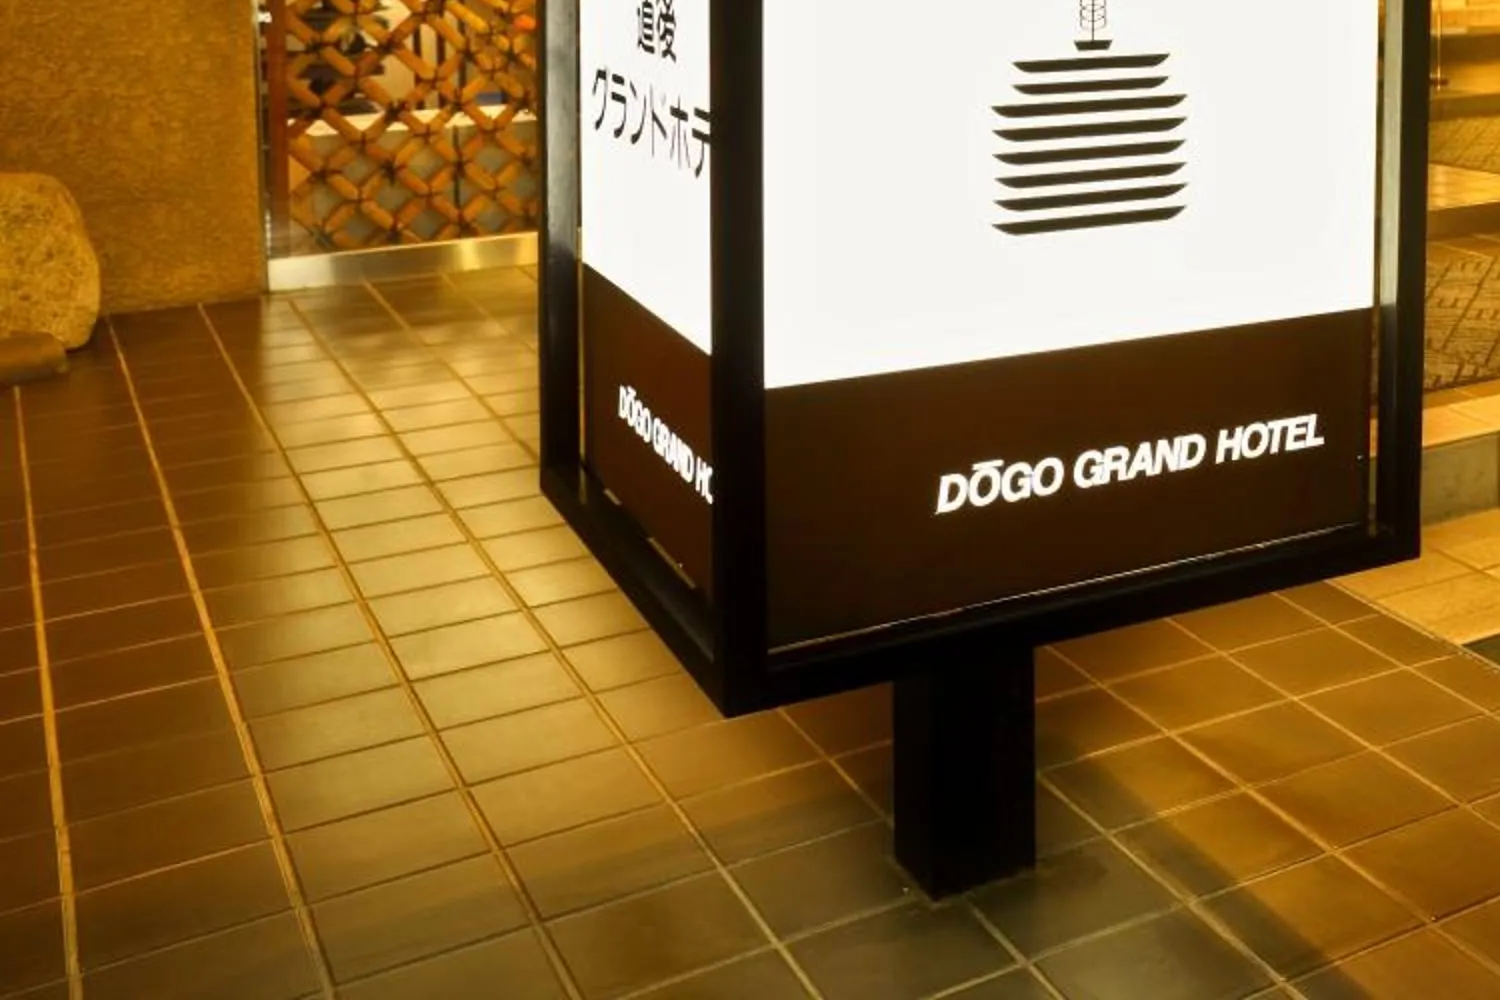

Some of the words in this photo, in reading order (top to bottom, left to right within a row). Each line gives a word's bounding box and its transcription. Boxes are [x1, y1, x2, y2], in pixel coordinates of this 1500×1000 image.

[653, 417, 694, 483] GRAND
[935, 457, 1064, 514] DŌGO
[1073, 433, 1206, 489] GRAND
[1215, 413, 1325, 464] HOTEL
